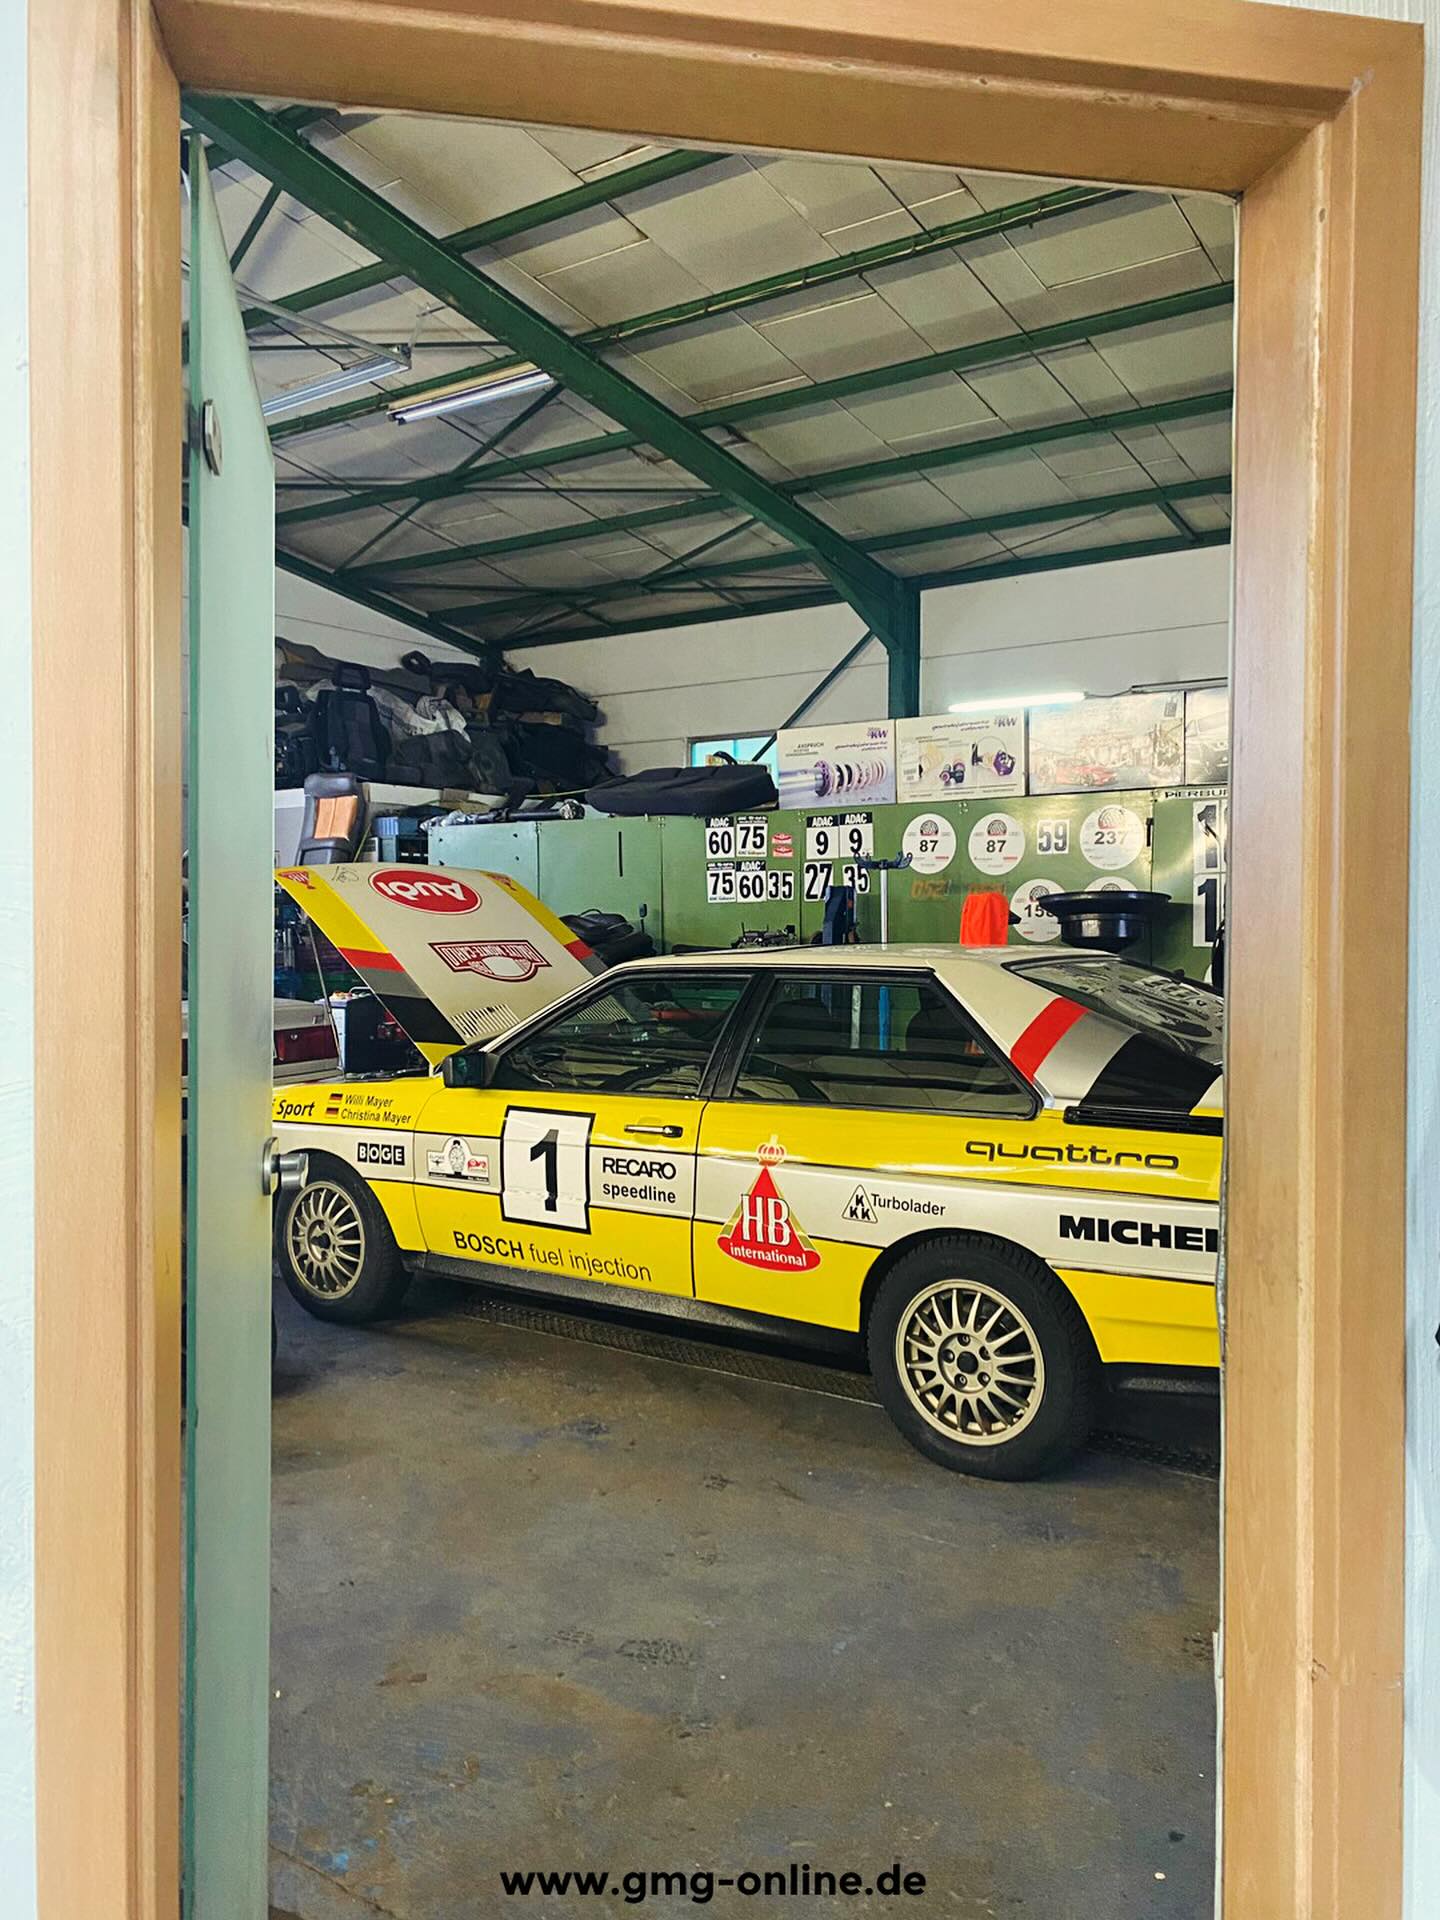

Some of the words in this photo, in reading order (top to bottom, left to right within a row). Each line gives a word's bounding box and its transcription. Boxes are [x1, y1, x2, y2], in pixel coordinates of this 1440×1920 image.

[710, 817, 730, 828] ADAC
[812, 816, 834, 827] ADAC
[843, 813, 868, 825] ADAC
[709, 831, 732, 855] 60
[739, 826, 765, 849] 75
[815, 831, 829, 855] 9
[849, 828, 863, 853] 9
[919, 840, 939, 852] 87
[986, 840, 1007, 853] 87
[1038, 821, 1068, 852] 59
[1094, 831, 1128, 845] 237
[709, 872, 734, 895] 75
[739, 875, 764, 899] 60
[769, 872, 793, 899] 35
[805, 864, 833, 900] 27
[844, 866, 869, 892] 35
[277, 1100, 315, 1119] Sport
[345, 1094, 364, 1105] Willi
[367, 1096, 393, 1109] Mayer
[341, 1108, 380, 1122] Christina
[383, 1112, 412, 1126] Mayer
[357, 1142, 405, 1166] BOGE
[965, 1140, 1180, 1170] quattro
[530, 1129, 559, 1212] 1
[602, 1157, 677, 1180] RECARO
[602, 1183, 676, 1204] speedline
[855, 1194, 864, 1207] K
[871, 1193, 947, 1216] Turbolader
[741, 1193, 791, 1247] HB
[453, 1231, 525, 1260] BOSCH
[529, 1243, 565, 1267] fuel
[568, 1249, 652, 1282] injection
[730, 1243, 808, 1267] international
